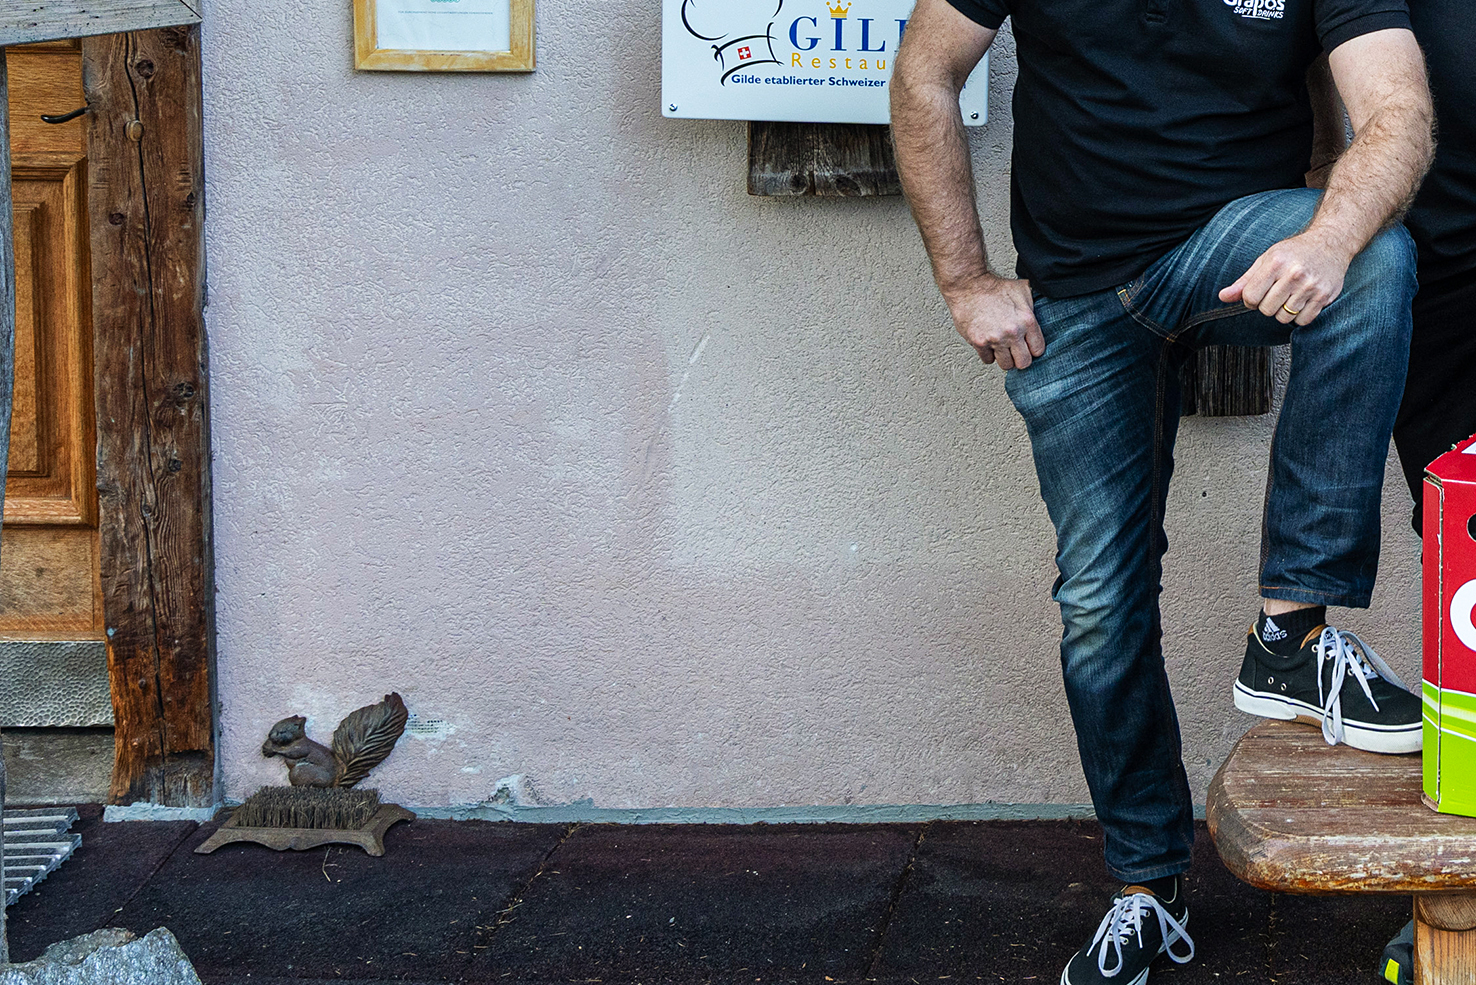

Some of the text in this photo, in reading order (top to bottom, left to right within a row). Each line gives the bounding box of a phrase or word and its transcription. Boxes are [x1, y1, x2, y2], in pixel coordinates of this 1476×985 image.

[1233, 6, 1284, 19] SOFT DRINKS
[731, 74, 886, 88] Gilde etablierter Schweizer
